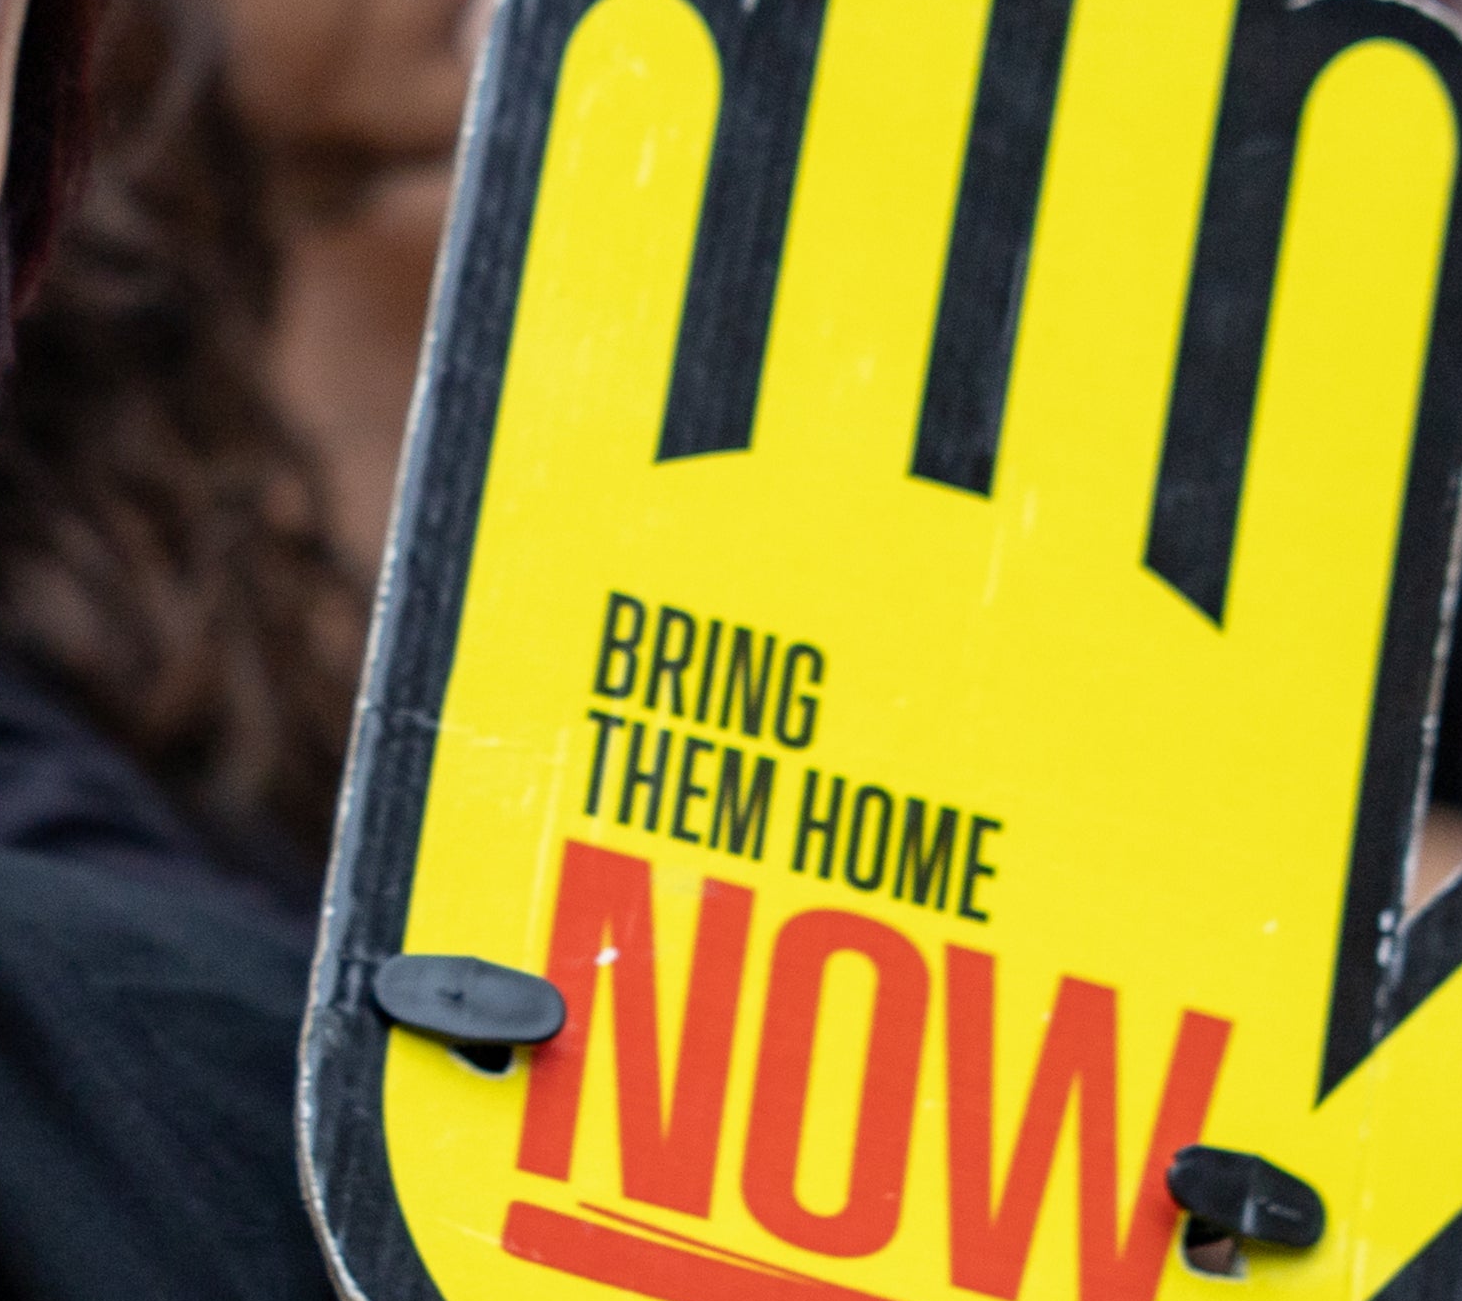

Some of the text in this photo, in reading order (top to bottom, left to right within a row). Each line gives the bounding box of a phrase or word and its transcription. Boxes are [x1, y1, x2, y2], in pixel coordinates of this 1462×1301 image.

[592, 590, 826, 751] BRING
[582, 709, 1003, 924] THEM HOME
